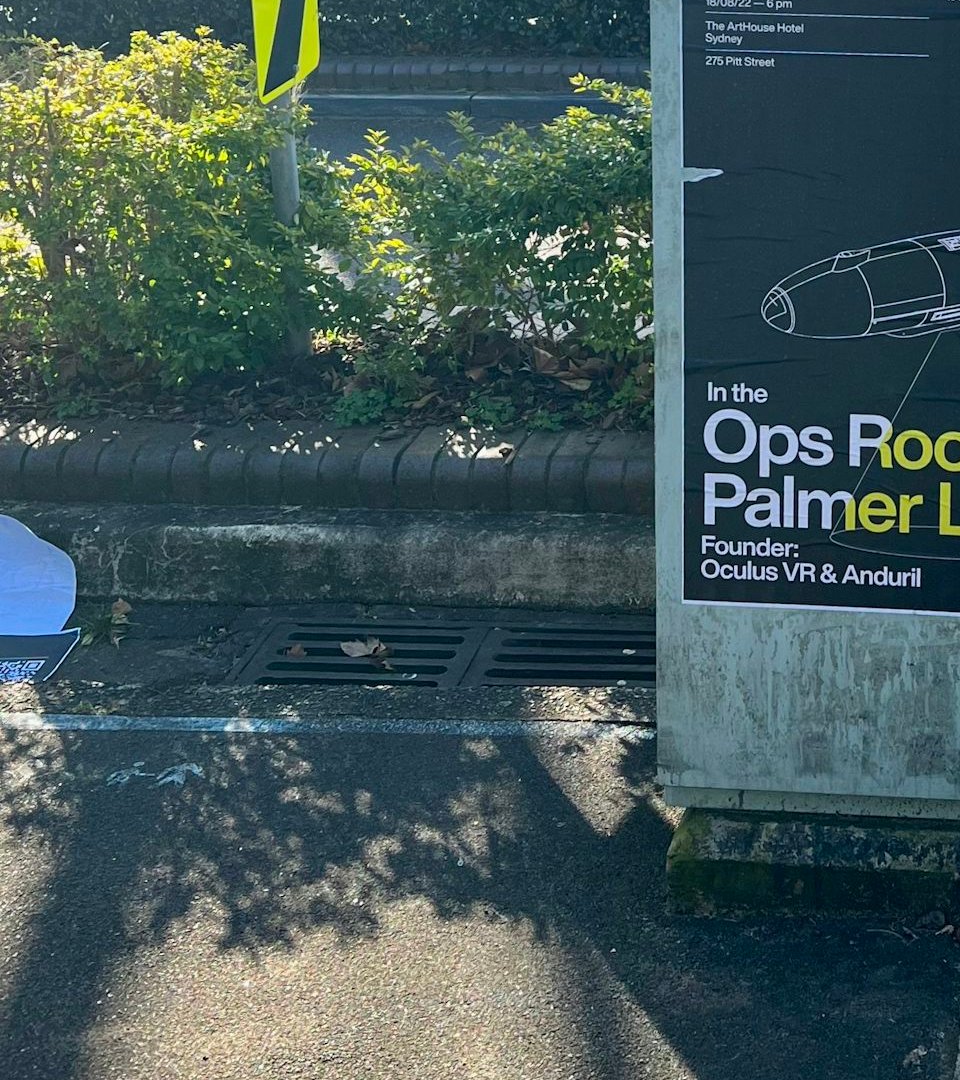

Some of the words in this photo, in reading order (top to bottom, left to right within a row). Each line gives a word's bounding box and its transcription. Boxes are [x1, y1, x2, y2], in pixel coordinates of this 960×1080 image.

[775, 0, 793, 10] pm
[705, 21, 725, 31] The
[727, 21, 775, 32] ArtHouse
[777, 23, 804, 33] Hotel
[705, 33, 743, 46] Sydney
[705, 55, 724, 66] 275
[725, 56, 742, 67] Pitt
[744, 56, 775, 67] Street
[707, 381, 727, 402] In
[731, 383, 769, 403] the
[703, 408, 834, 478] Ops
[703, 472, 923, 534] Palmer
[700, 535, 799, 558] Founder:
[700, 558, 779, 582] Oculus
[782, 562, 816, 583] VR
[820, 563, 837, 584] &
[842, 564, 922, 588] Anduril
